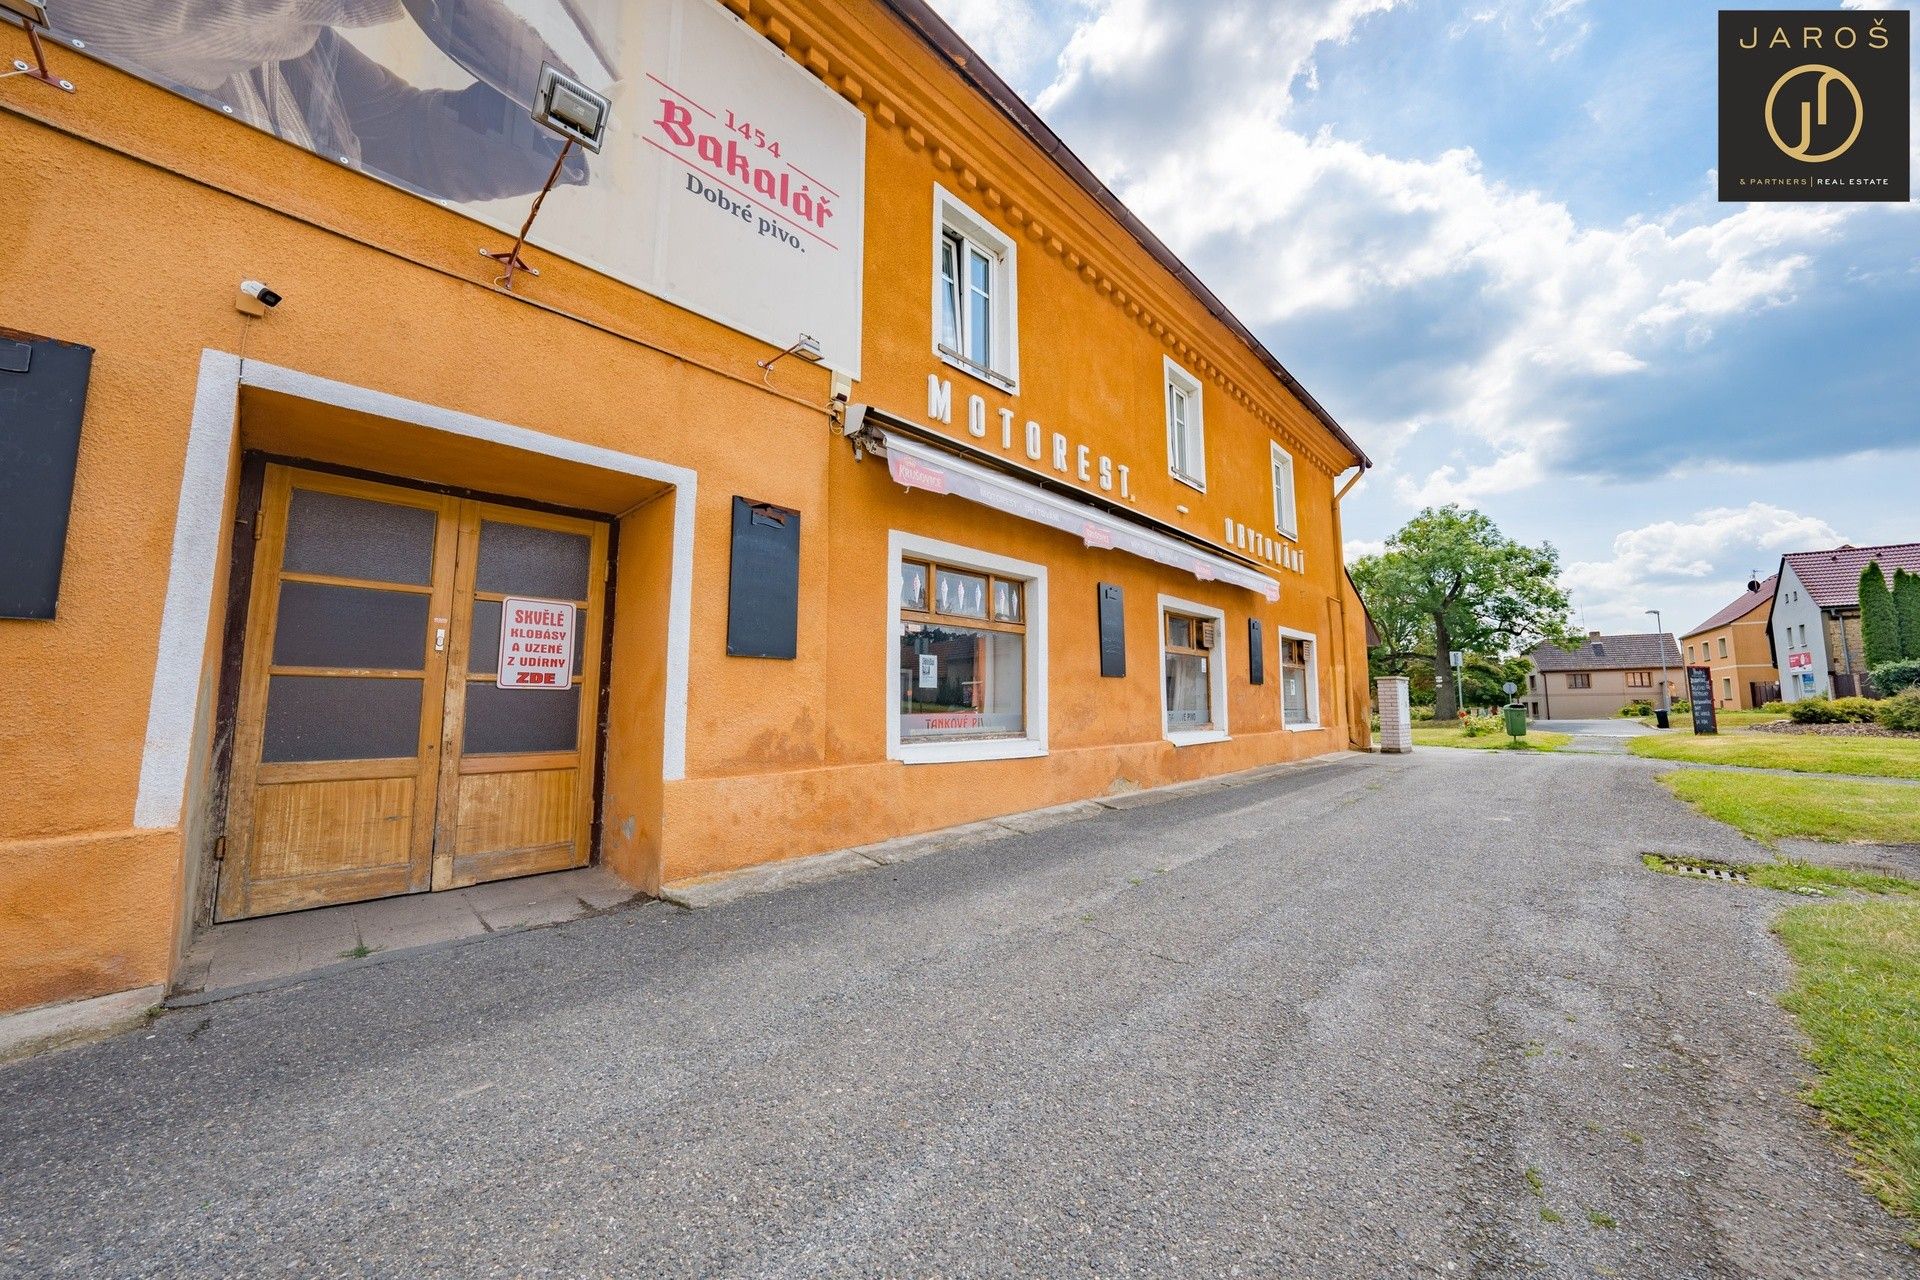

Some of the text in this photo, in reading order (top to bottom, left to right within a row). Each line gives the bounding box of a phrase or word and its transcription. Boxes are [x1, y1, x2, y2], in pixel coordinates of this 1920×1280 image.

[724, 108, 781, 159] 1454
[653, 98, 834, 228] Bakalář
[685, 172, 806, 253] Dobré pivo.
[515, 609, 564, 627] SKVĚLÉ
[510, 628, 567, 641] KLOBÁSY
[511, 642, 563, 654] A UZENÉ
[507, 656, 566, 668] Z UDÍRNY
[516, 671, 556, 684] ZDE
[925, 714, 968, 730] TANKOVÉ
